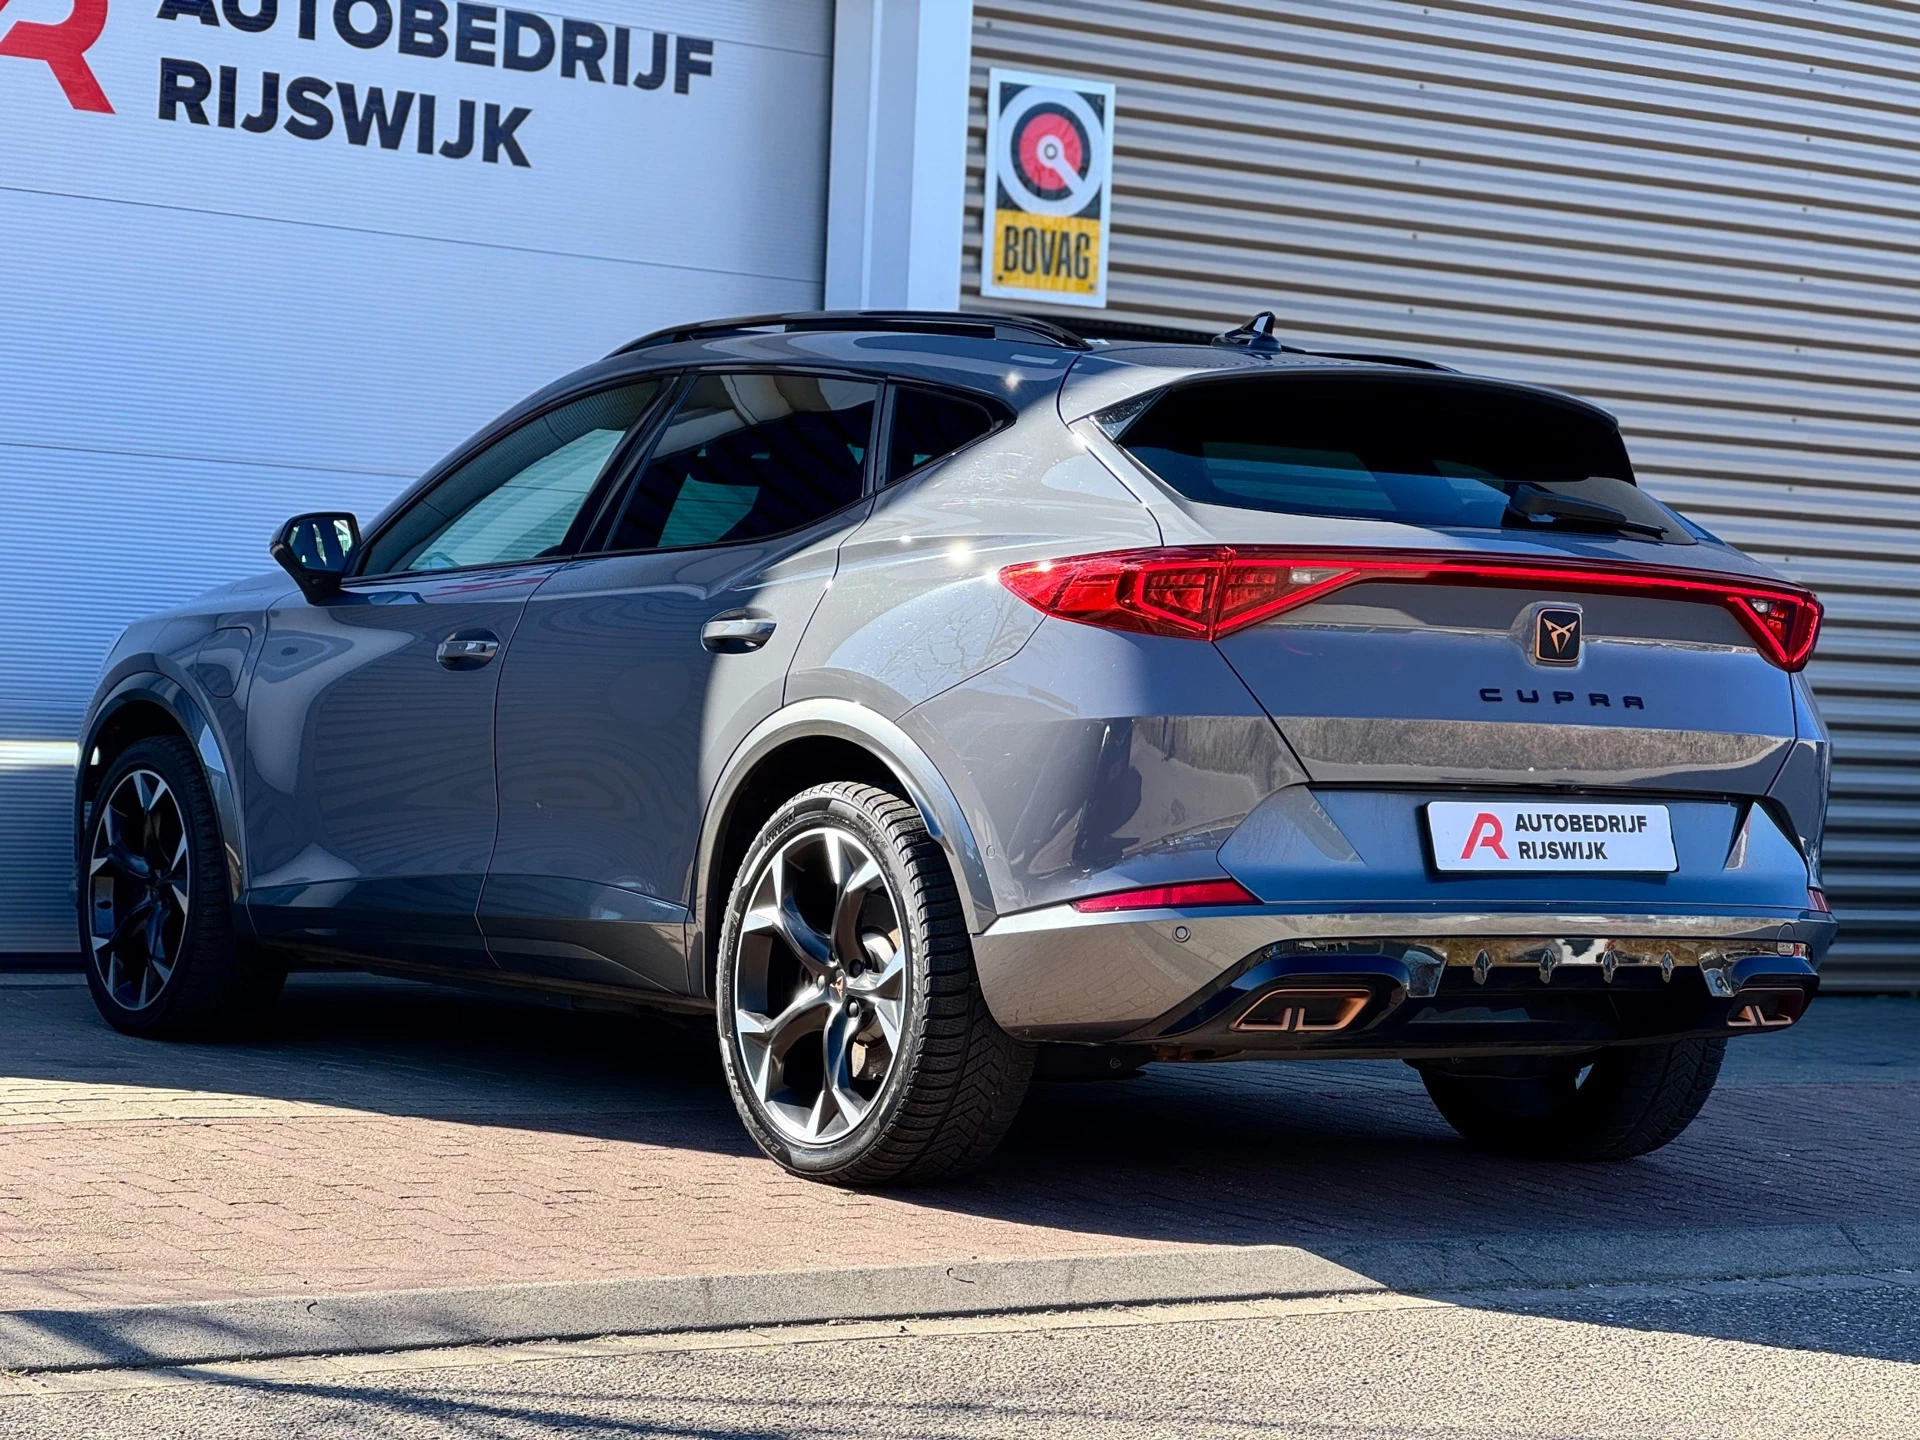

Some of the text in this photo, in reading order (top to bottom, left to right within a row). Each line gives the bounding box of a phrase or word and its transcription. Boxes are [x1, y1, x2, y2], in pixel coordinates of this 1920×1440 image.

[158, 57, 533, 168] RIJSWIJK
[1003, 225, 1090, 280] BOVAG
[1479, 688, 1645, 710] CUPRA
[1515, 813, 1648, 834] AUTOBEDRIJF
[1518, 841, 1608, 860] RIJSWIJK
